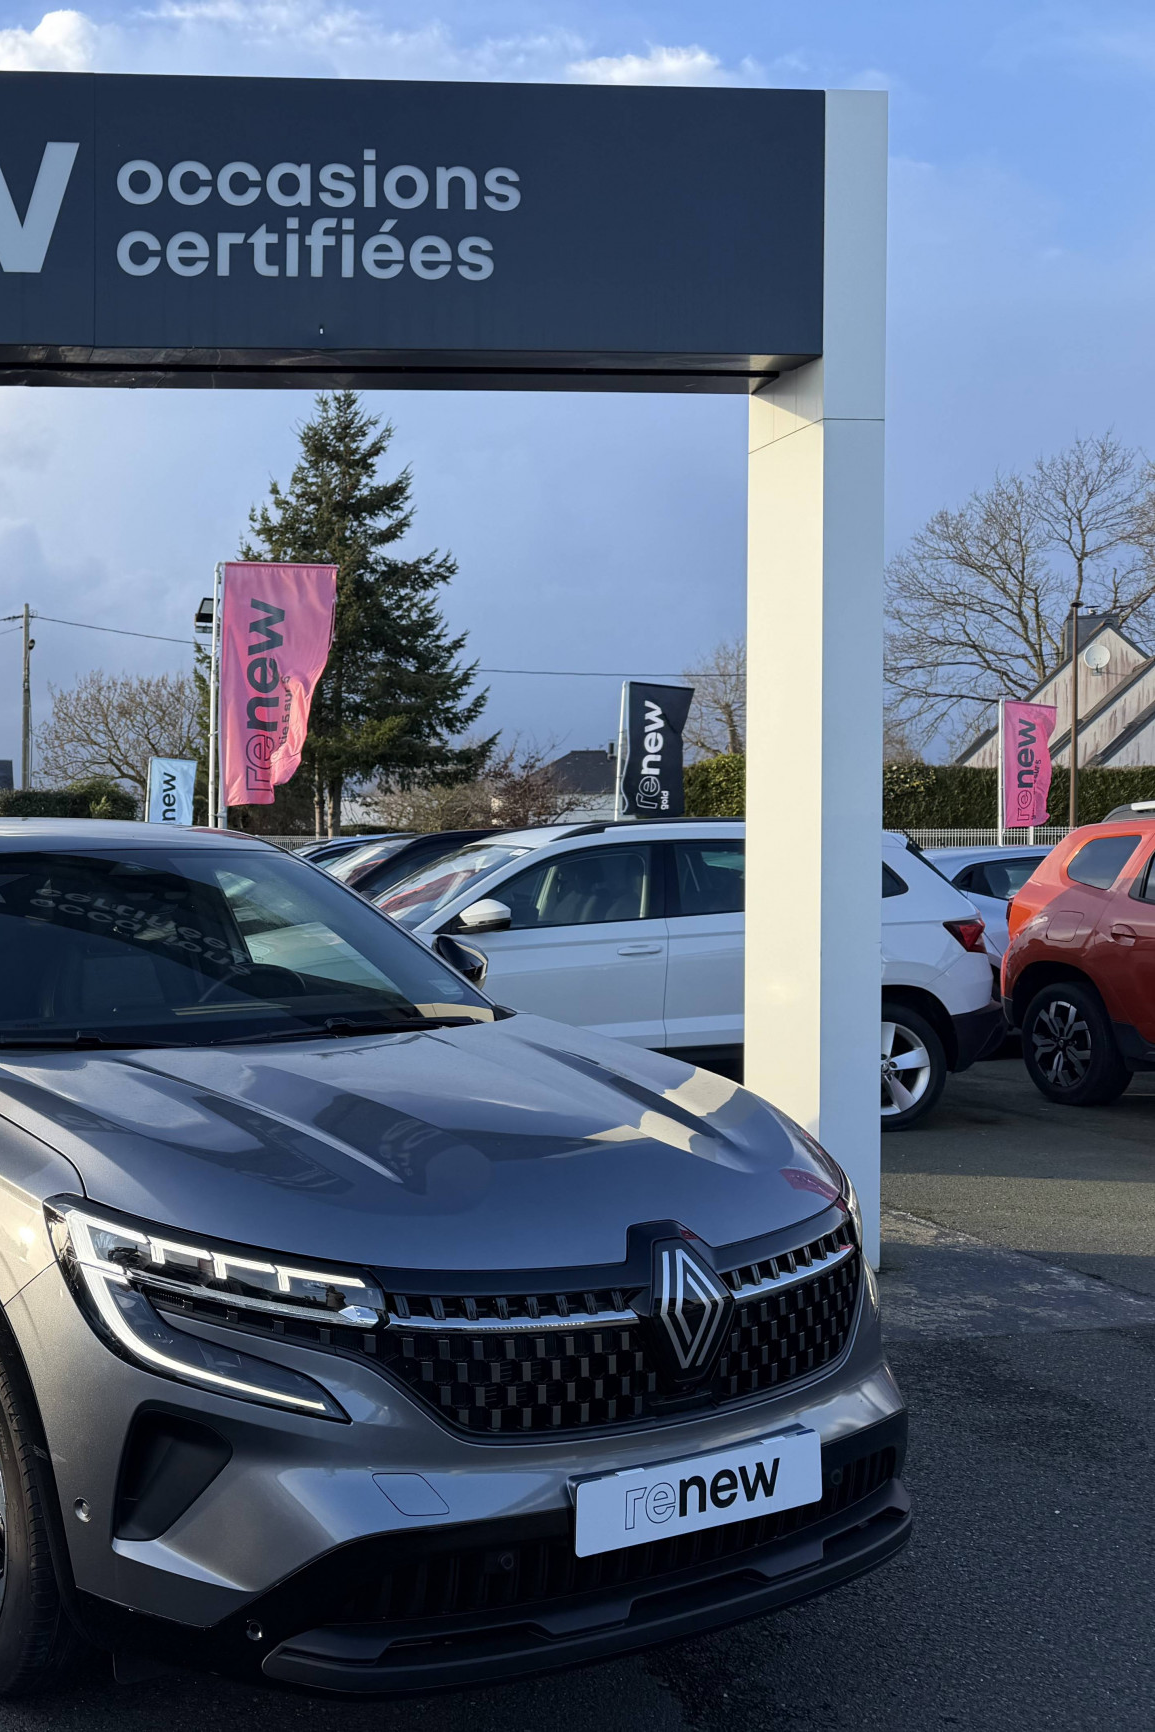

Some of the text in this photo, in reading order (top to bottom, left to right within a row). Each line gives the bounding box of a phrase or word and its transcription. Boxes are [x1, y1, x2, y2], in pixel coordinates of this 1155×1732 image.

[116, 148, 522, 212] occasions
[116, 217, 495, 281] certifiées
[246, 598, 285, 793] renew
[636, 700, 665, 810] renew
[1017, 718, 1037, 822] renew
[661, 790, 670, 810] gold
[625, 1457, 780, 1531] renew
